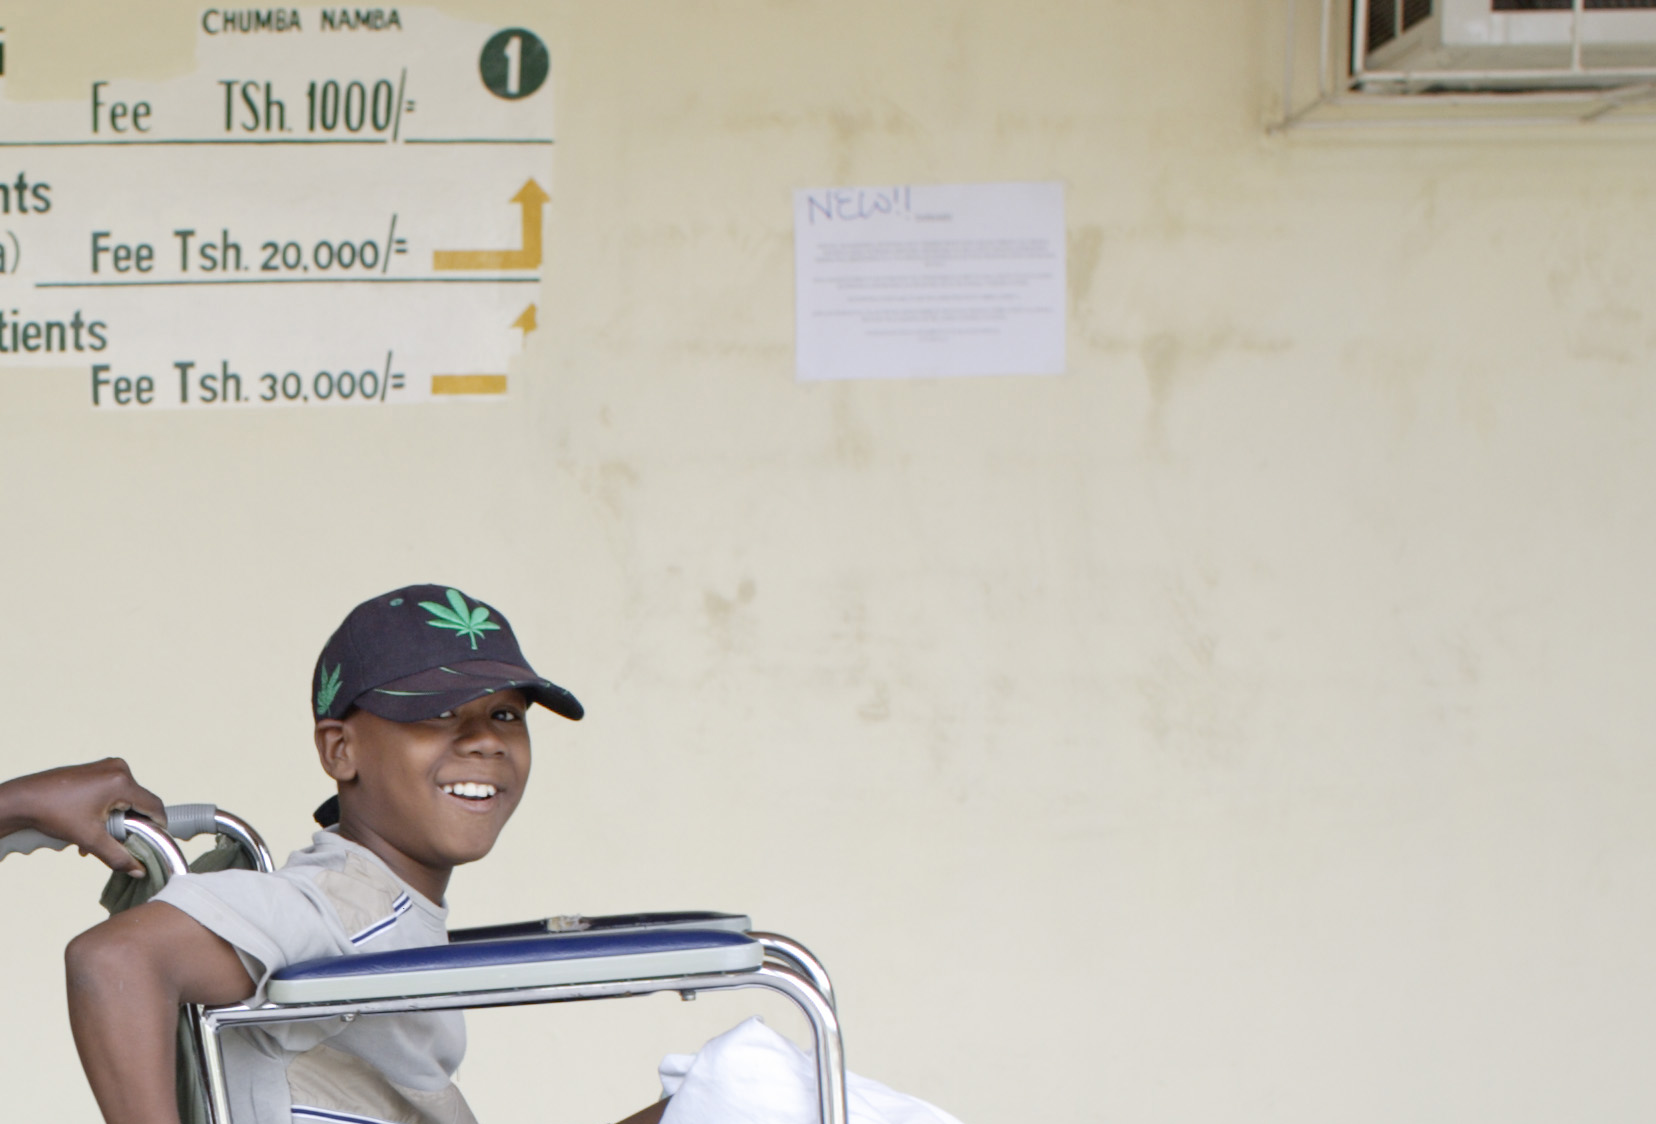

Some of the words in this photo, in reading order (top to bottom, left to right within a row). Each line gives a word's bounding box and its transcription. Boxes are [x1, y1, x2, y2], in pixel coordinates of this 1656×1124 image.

[202, 9, 301, 34] CHUMBA
[321, 8, 401, 32] NAMBA
[503, 37, 522, 93] 1
[92, 82, 151, 133] Fee
[219, 81, 291, 133] TSh.
[305, 67, 418, 142] 1000/=
[91, 232, 155, 273] Fee
[174, 230, 248, 273] Tsh.
[260, 215, 409, 273] 20,000/=
[91, 366, 155, 406] Fee
[174, 361, 248, 405] Tsh.
[260, 352, 406, 404] 30,000/=
